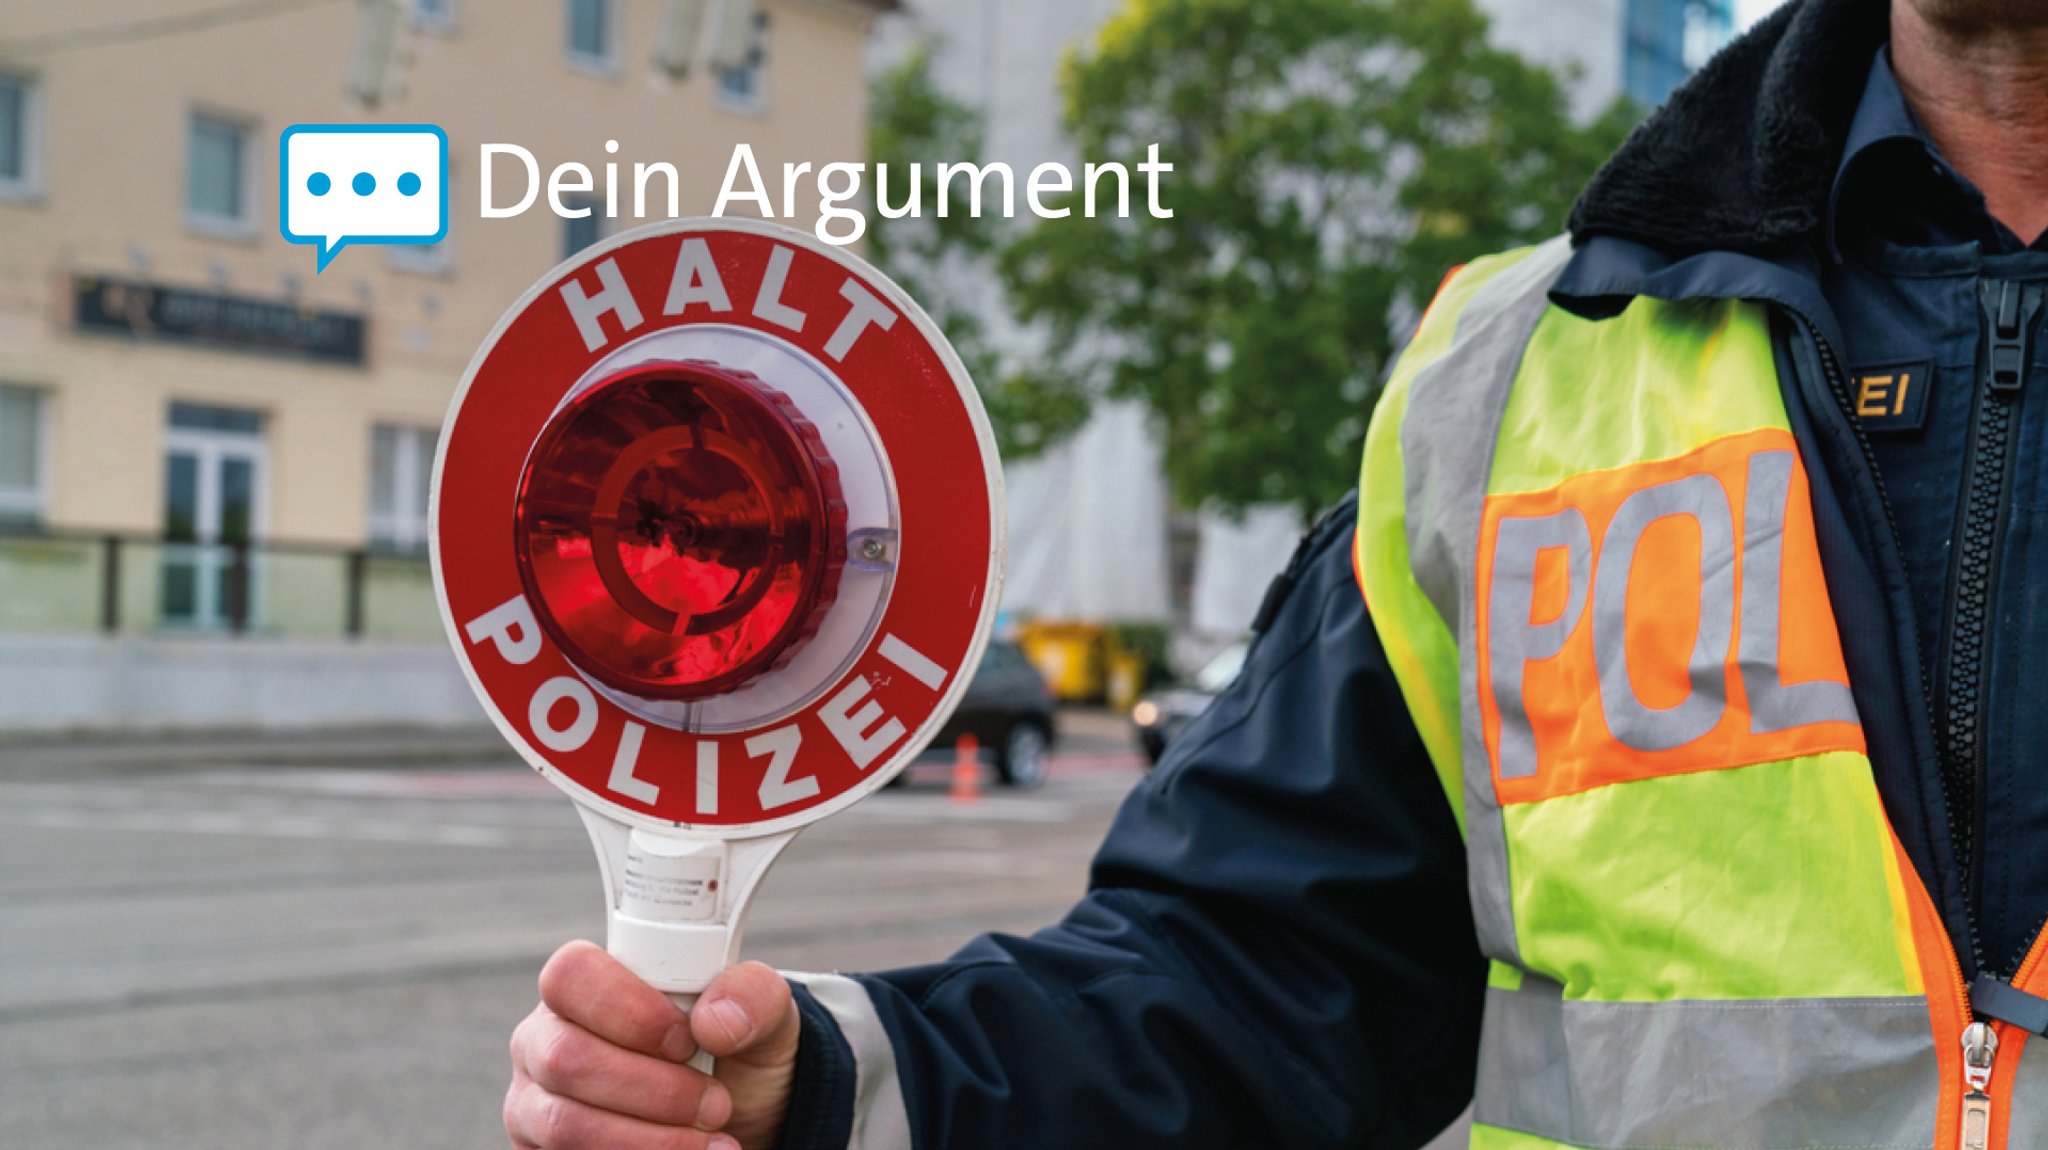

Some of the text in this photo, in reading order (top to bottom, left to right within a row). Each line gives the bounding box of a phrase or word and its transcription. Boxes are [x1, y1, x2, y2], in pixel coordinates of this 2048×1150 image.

[558, 236, 898, 363] HALT
[1851, 373, 1910, 417] EI
[1488, 450, 1861, 780] POL
[464, 594, 947, 816] POLIZEI
